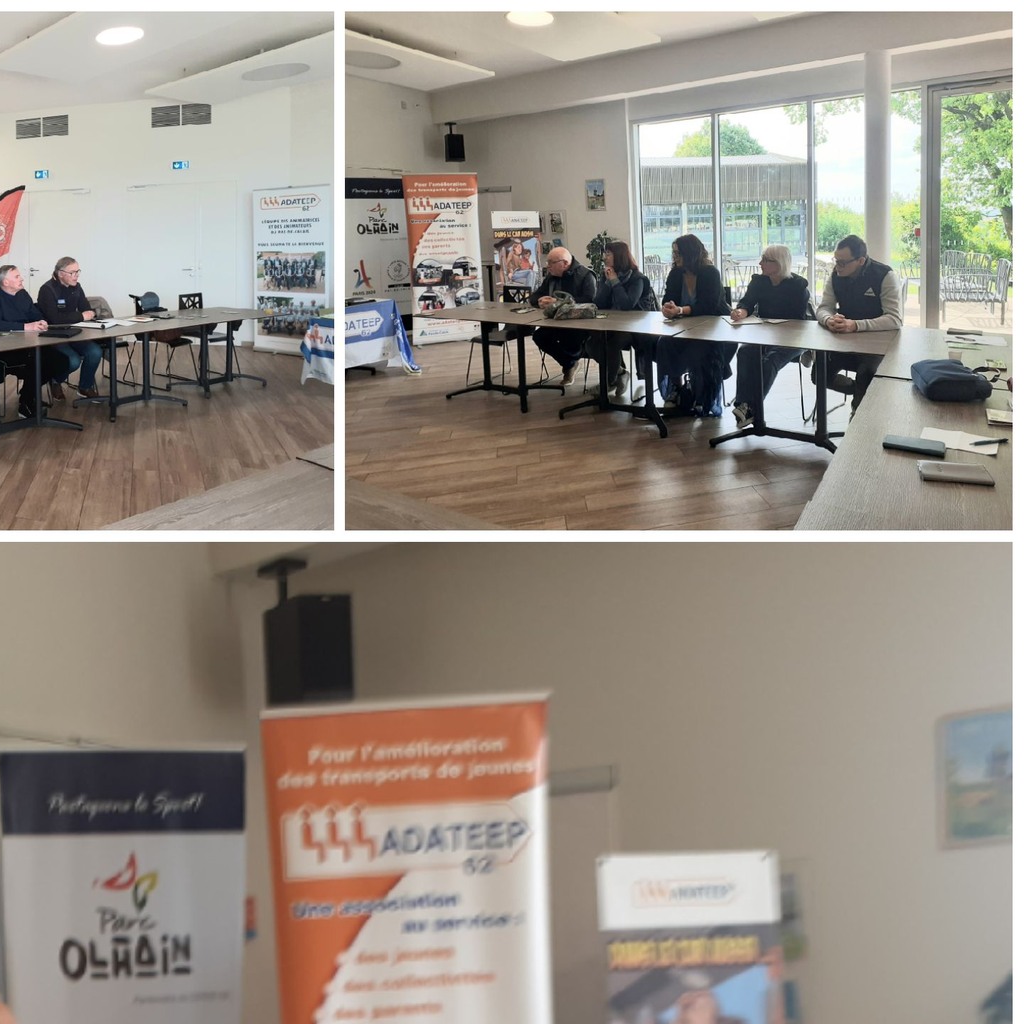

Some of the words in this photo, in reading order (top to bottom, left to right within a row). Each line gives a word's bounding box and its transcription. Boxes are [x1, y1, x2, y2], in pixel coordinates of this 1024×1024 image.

[281, 197, 316, 206] ADATEEP
[434, 202, 472, 210] ADATEEP
[308, 745, 355, 765] Pour
[361, 737, 506, 762] l'amélioration
[278, 770, 316, 789] des
[321, 763, 430, 790] transports
[436, 762, 464, 779] de
[467, 757, 536, 780] jeunes
[380, 820, 527, 856] ADATEEP
[463, 855, 494, 875] 62
[96, 907, 157, 934] Parc
